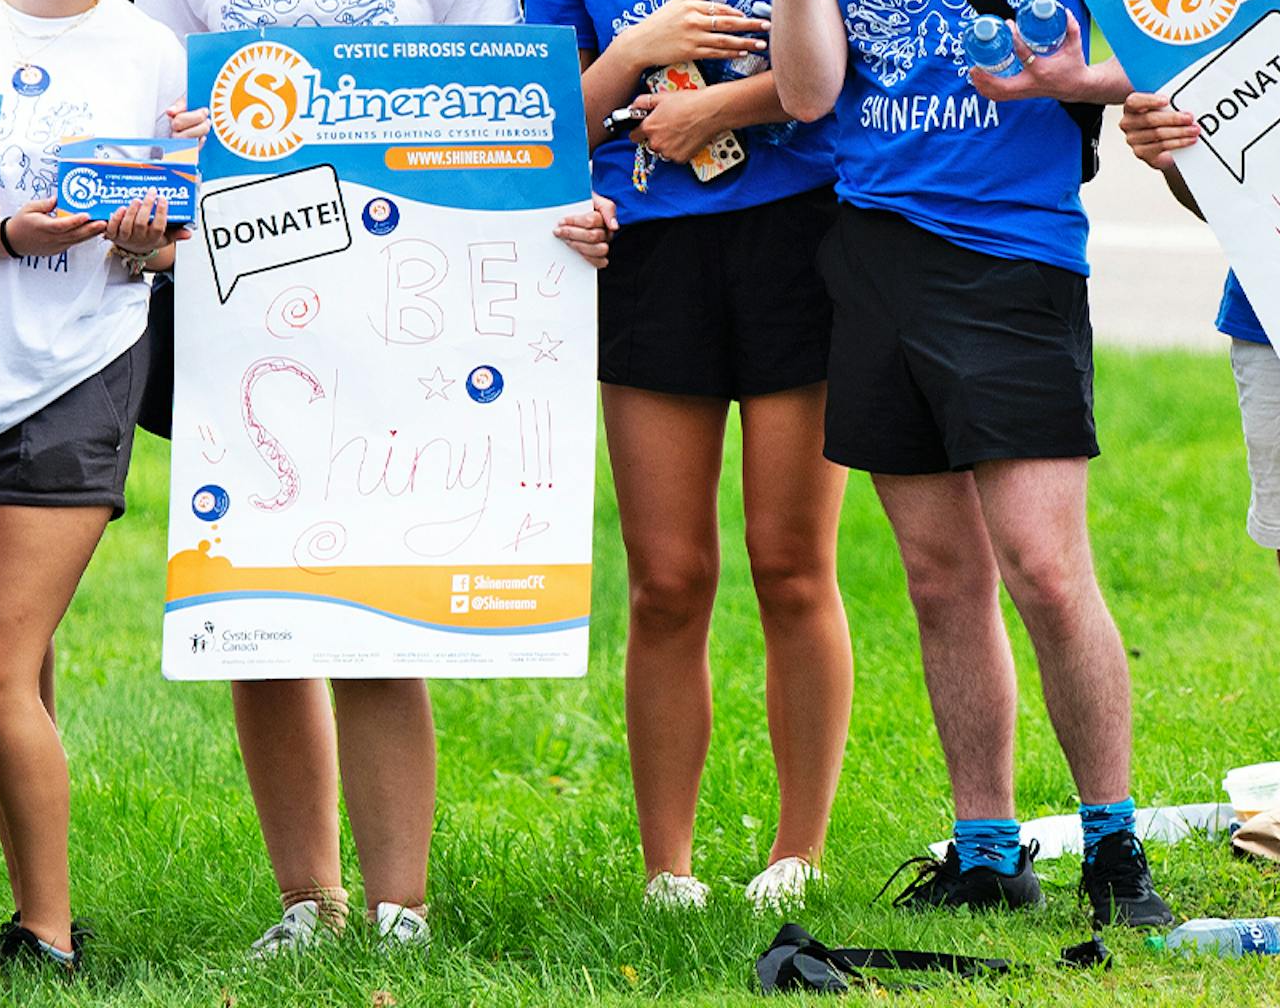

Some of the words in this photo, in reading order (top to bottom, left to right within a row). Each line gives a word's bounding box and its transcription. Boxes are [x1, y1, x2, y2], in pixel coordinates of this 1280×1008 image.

[333, 43, 389, 59] CYSTIC
[393, 42, 466, 59] FIBROSIS
[469, 42, 549, 59] CANADA'S
[234, 66, 552, 135] Shinerama
[860, 94, 1000, 134] SHINERAMA
[316, 130, 377, 141] STUDENTS
[383, 129, 443, 140] FIGHTING
[448, 129, 490, 139] CYSTIC
[495, 128, 549, 139] FIBROSIS
[406, 151, 532, 166] WWW.SHINERAMA.CA
[212, 200, 341, 250] DONATE!
[366, 238, 518, 346] BE
